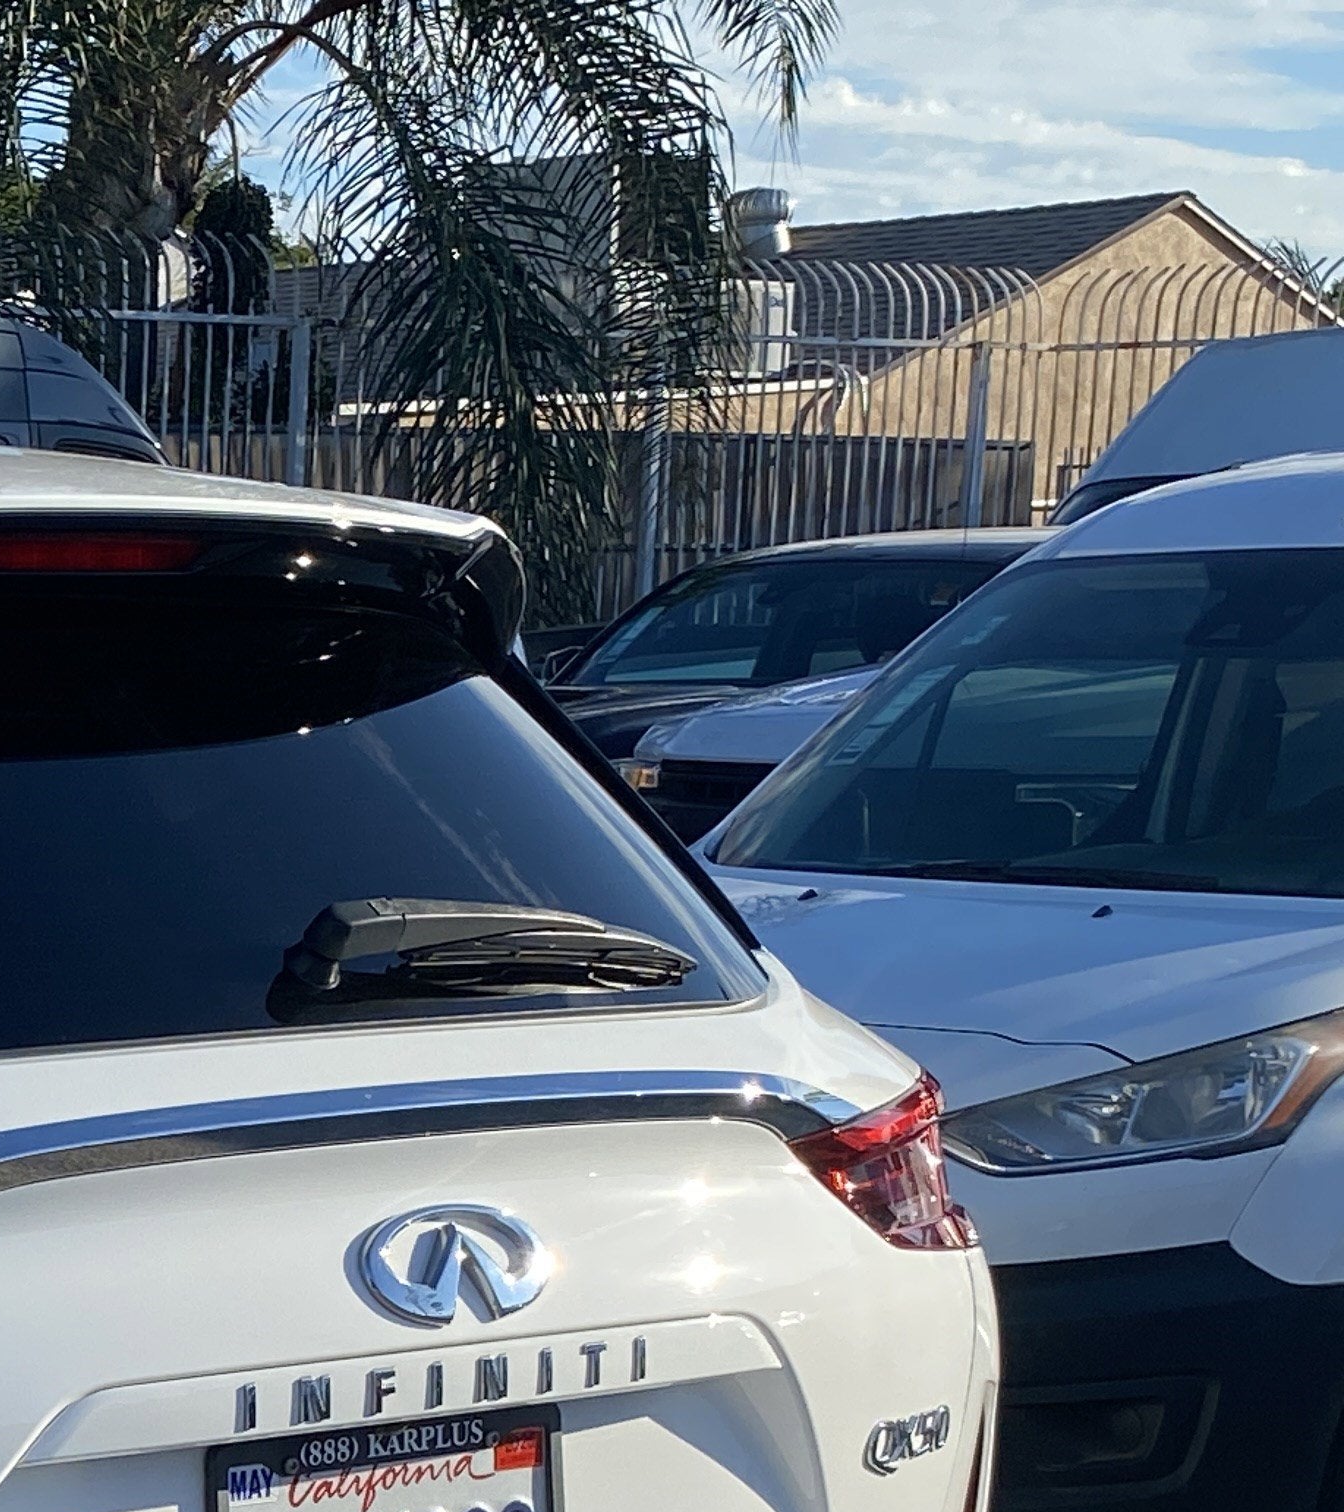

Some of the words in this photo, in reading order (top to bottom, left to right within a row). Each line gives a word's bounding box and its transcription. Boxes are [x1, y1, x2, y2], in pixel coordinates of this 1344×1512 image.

[233, 1335, 647, 1433] INFINITI
[299, 1436, 359, 1468] (888)
[367, 1418, 485, 1458] KARPLUS
[229, 1467, 274, 1503] MAY
